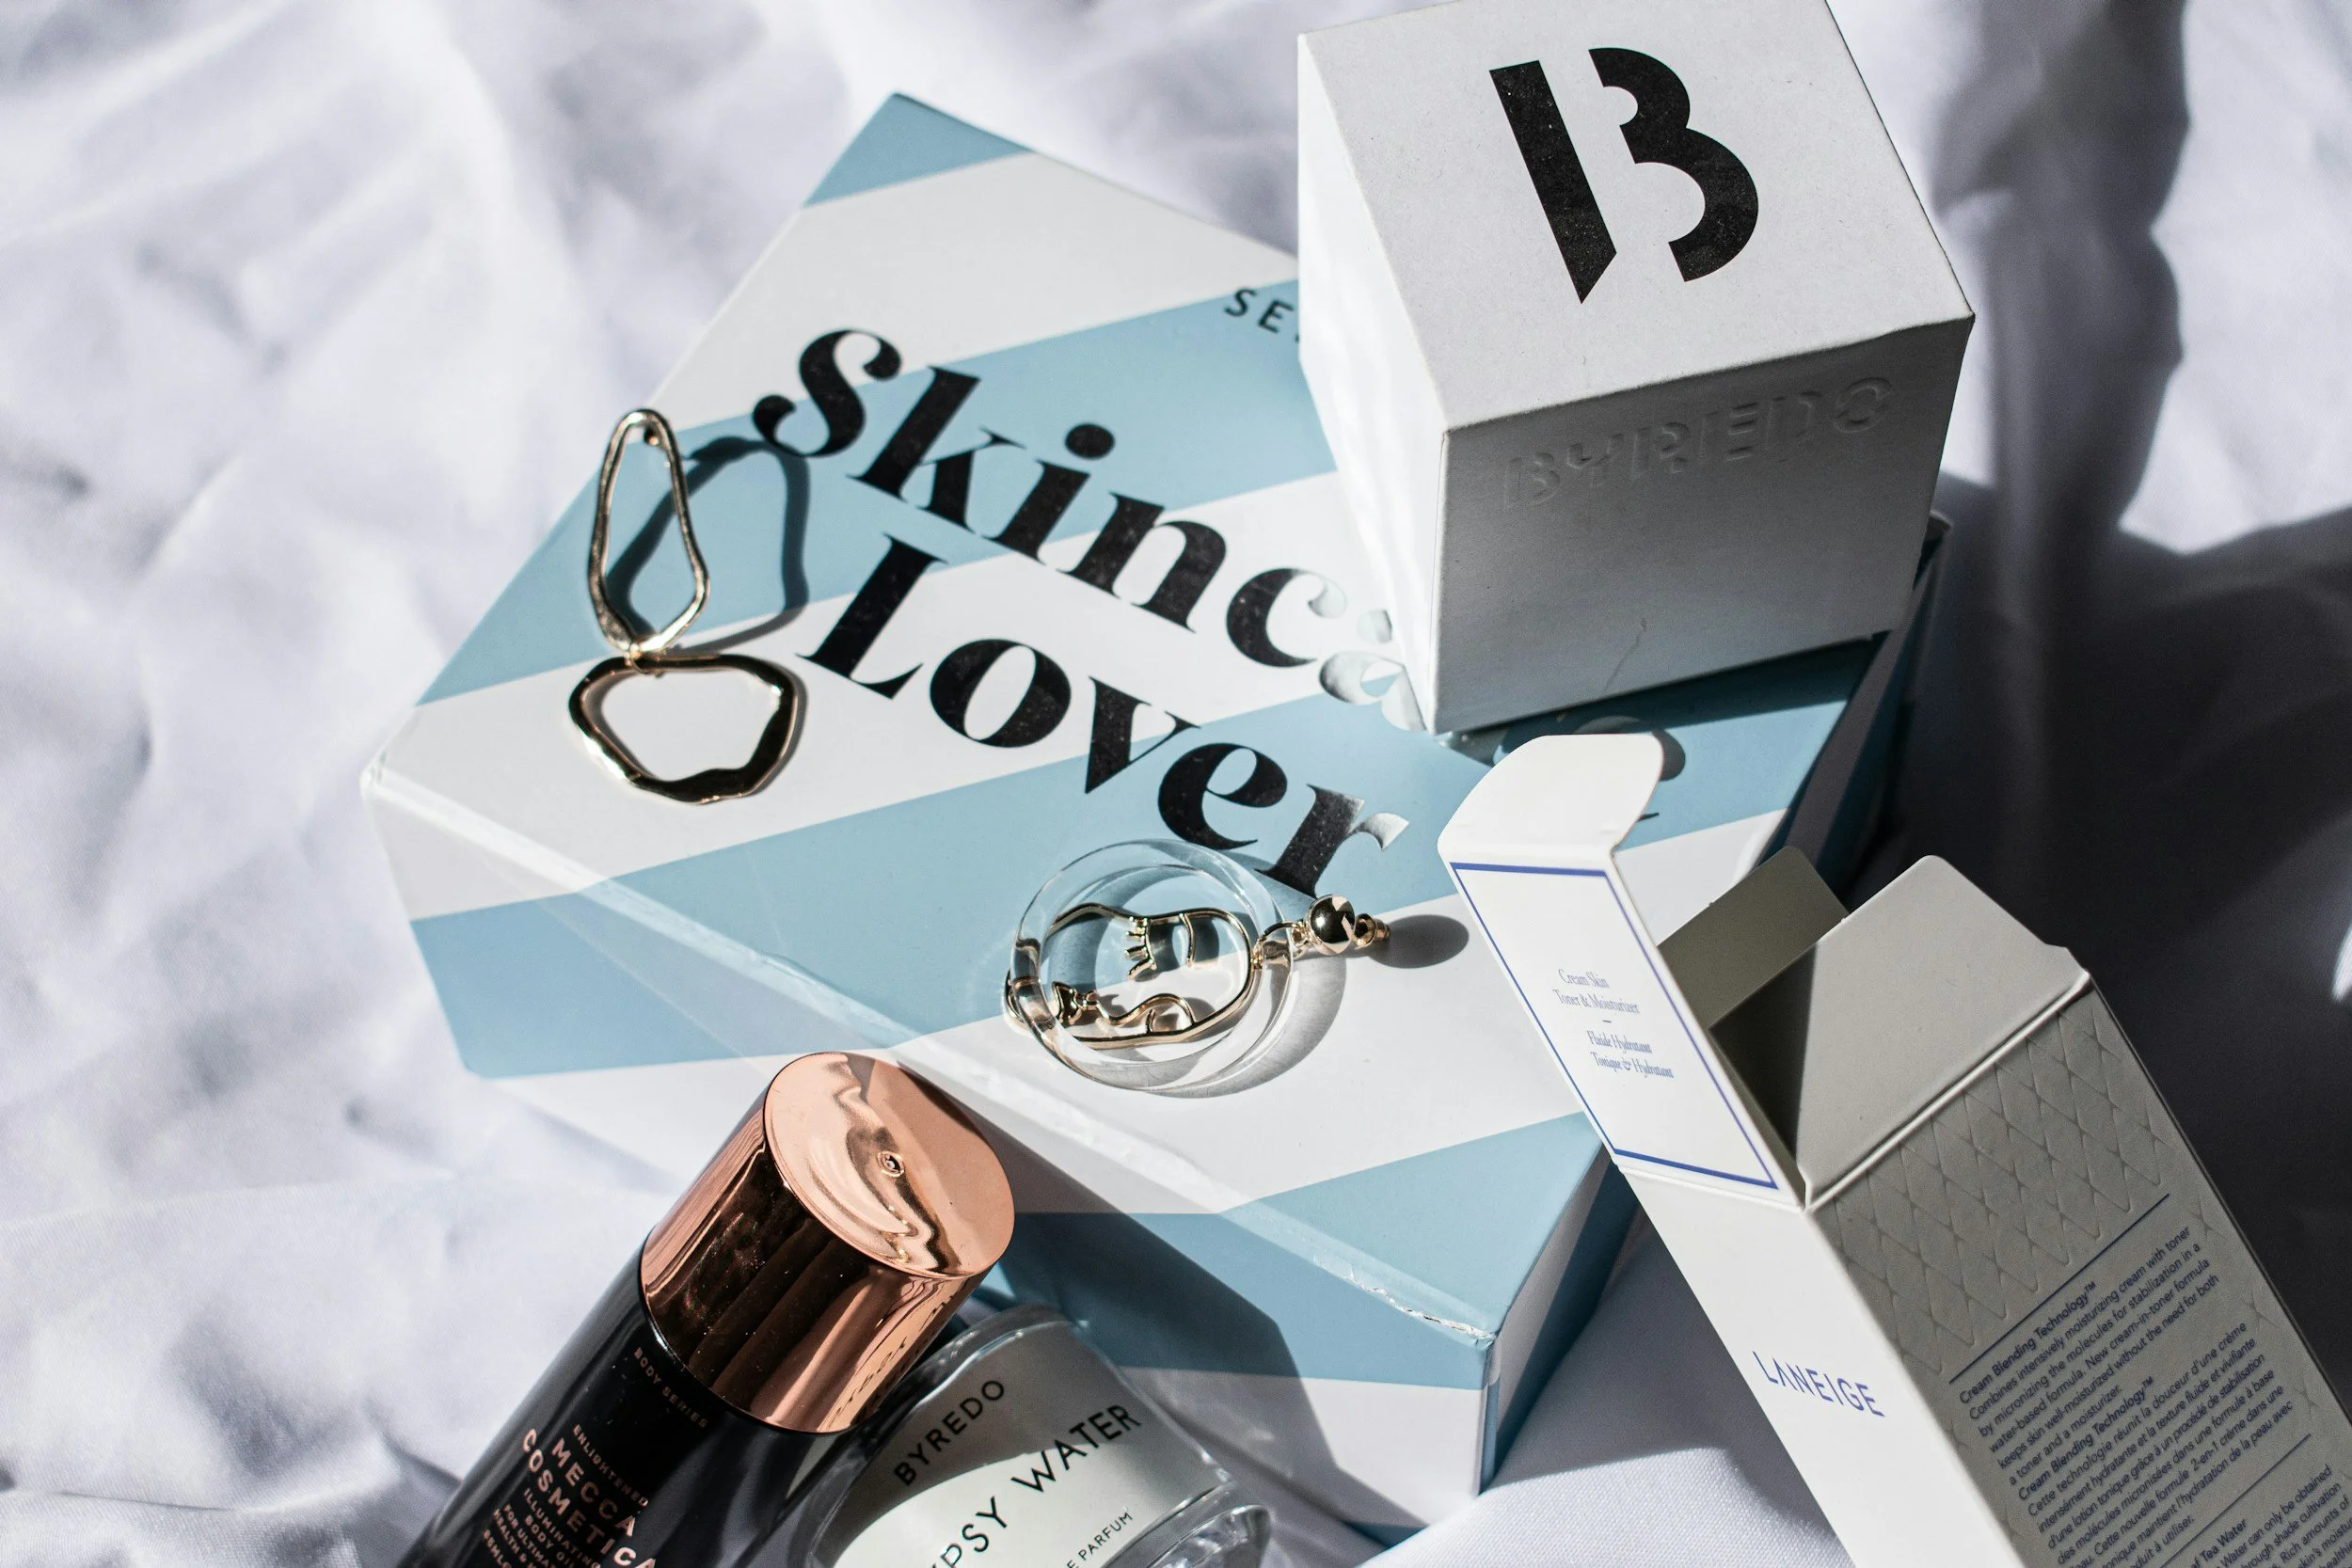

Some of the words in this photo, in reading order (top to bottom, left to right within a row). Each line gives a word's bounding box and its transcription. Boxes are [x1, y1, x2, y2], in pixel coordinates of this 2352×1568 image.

[1489, 47, 1758, 304] B
[1223, 288, 1299, 342] SE
[1502, 376, 1893, 509] BYREDO
[796, 533, 1409, 897] Lover
[1552, 989, 1581, 1006] Toner
[1580, 994, 1591, 1007] &
[1587, 993, 1640, 1013] Moisturizer
[1558, 969, 1590, 986] Cream
[1586, 972, 1610, 988] Skin
[1587, 1030, 1613, 1048] Fluide
[1611, 1034, 1652, 1053] Hydratant
[1590, 1052, 1622, 1073] Tonique
[1632, 1058, 1674, 1078] Hydratant
[1970, 1378, 2018, 1419] Combines
[2016, 1337, 2065, 1379] intensively
[2065, 1291, 2120, 1339] moisturizing
[2119, 1266, 2147, 1292] cream
[2146, 1248, 2166, 1267] with
[2165, 1227, 2190, 1250] toner
[1978, 1422, 1994, 1436] by
[1994, 1376, 2049, 1424] micronizing
[2048, 1361, 2066, 1377] the
[2066, 1320, 2114, 1362] molecules
[2112, 1306, 2127, 1321] for
[2128, 1259, 2183, 1308] stabilization
[2181, 1250, 2193, 1261] in
[2193, 1243, 2201, 1252] a
[1989, 1399, 2047, 1452] water-based
[2046, 1370, 2086, 1402] formula.
[2085, 1347, 2108, 1369] New
[2110, 1289, 2174, 1349] cream-in-toner
[2173, 1259, 2210, 1291] formula
[633, 1347, 661, 1384] BODY
[662, 1386, 707, 1428] SERIES
[1752, 1351, 1885, 1417] LANEIGE
[1960, 1374, 1993, 1403] Cream
[1992, 1338, 2037, 1376] Blending
[1997, 1443, 2027, 1468] keeps
[2026, 1428, 2045, 1445] skin
[2044, 1364, 2115, 1429] well-moisturized
[2113, 1338, 2148, 1370] without
[2146, 1326, 2164, 1340] the
[2162, 1302, 2185, 1327] need
[2184, 1293, 2198, 1307] for
[2196, 1275, 2219, 1296] both
[895, 1380, 1005, 1486] BYREDO
[2010, 1476, 2017, 1485] a
[2016, 1452, 2042, 1478] toner
[2043, 1433, 2063, 1455] and
[2063, 1430, 2071, 1438] a
[2071, 1385, 2122, 1432] moisturizer.
[2028, 1491, 2056, 1516] Cette
[2057, 1441, 2113, 1492] technologie
[2114, 1416, 2141, 1443] réunit
[2140, 1407, 2152, 1418] la
[2153, 1371, 2189, 1409] douceur
[2191, 1349, 2217, 1374] d'une
[2218, 1323, 2247, 1350] crème
[2037, 1482, 2092, 1533] intensément
[2090, 1444, 2137, 1487] hydratante
[2137, 1433, 2148, 1446] et
[2146, 1427, 2156, 1437] la
[2156, 1401, 2185, 1429] texture
[2185, 1380, 2210, 1402] fluide
[2211, 1370, 2220, 1381] et
[2219, 1338, 2257, 1372] vivifiante
[2048, 1524, 2074, 1549] d'une
[2072, 1502, 2098, 1527] lotion
[2097, 1474, 2131, 1505] tonique
[2131, 1453, 2154, 1479] grâce
[2153, 1445, 2161, 1455] à
[2161, 1436, 2173, 1450] un
[2172, 1404, 2207, 1442] procédé
[2207, 1395, 2219, 1408] de
[2219, 1354, 2265, 1398] stabilisation
[551, 1437, 635, 1537] MECCA
[573, 1424, 648, 1507] ENLIGHTENED
[931, 1496, 1007, 1568] PSY
[1010, 1405, 1141, 1492] WATER
[2019, 1471, 2051, 1500] Cream
[2051, 1433, 2094, 1472] Blending
[2058, 1546, 2076, 1564] des
[2075, 1507, 2122, 1549] molécules
[2121, 1461, 2172, 1509] micronisées
[2173, 1442, 2195, 1463] dans
[2194, 1426, 2212, 1444] une
[2212, 1396, 2246, 1428] formule
[2246, 1387, 2253, 1398] à
[2251, 1370, 2274, 1391] base
[2094, 1531, 2121, 1555] Cette
[2120, 1499, 2156, 1534] nouvelle
[2155, 1470, 2189, 1501] formule
[2191, 1441, 2218, 1471] 2-en-1
[2220, 1419, 2247, 1446] crème
[2247, 1401, 2267, 1421] dans
[2266, 1386, 2283, 1402] une
[2103, 1542, 2137, 1568] onique
[2137, 1504, 2178, 1544] maintient
[2176, 1459, 2230, 1507] l'hydratation
[2229, 1448, 2242, 1462] de
[2240, 1440, 2251, 1449] la
[2250, 1419, 2274, 1446] peau
[2272, 1401, 2293, 1423] avec
[493, 1508, 520, 1554] HEALTH
[502, 1503, 519, 1529] FOR
[525, 1514, 553, 1548] BODY
[1078, 1512, 1134, 1561] PARFUM
[2154, 1542, 2163, 1552] à
[2162, 1515, 2195, 1544] utiliser.
[2200, 1545, 2219, 1560] Tea
[2217, 1518, 2247, 1546] Water
[2220, 1543, 2249, 1568] Water
[2249, 1528, 2265, 1545] can
[2264, 1512, 2282, 1530] only
[2280, 1501, 2296, 1514] be
[2295, 1464, 2332, 1502] obtained
[2274, 1521, 2300, 1545] shade
[2299, 1483, 2342, 1522] cultivation
[2280, 1543, 2301, 1562] Rich
[2301, 1509, 2341, 1544] amounts
[2340, 1494, 2349, 1510] of
